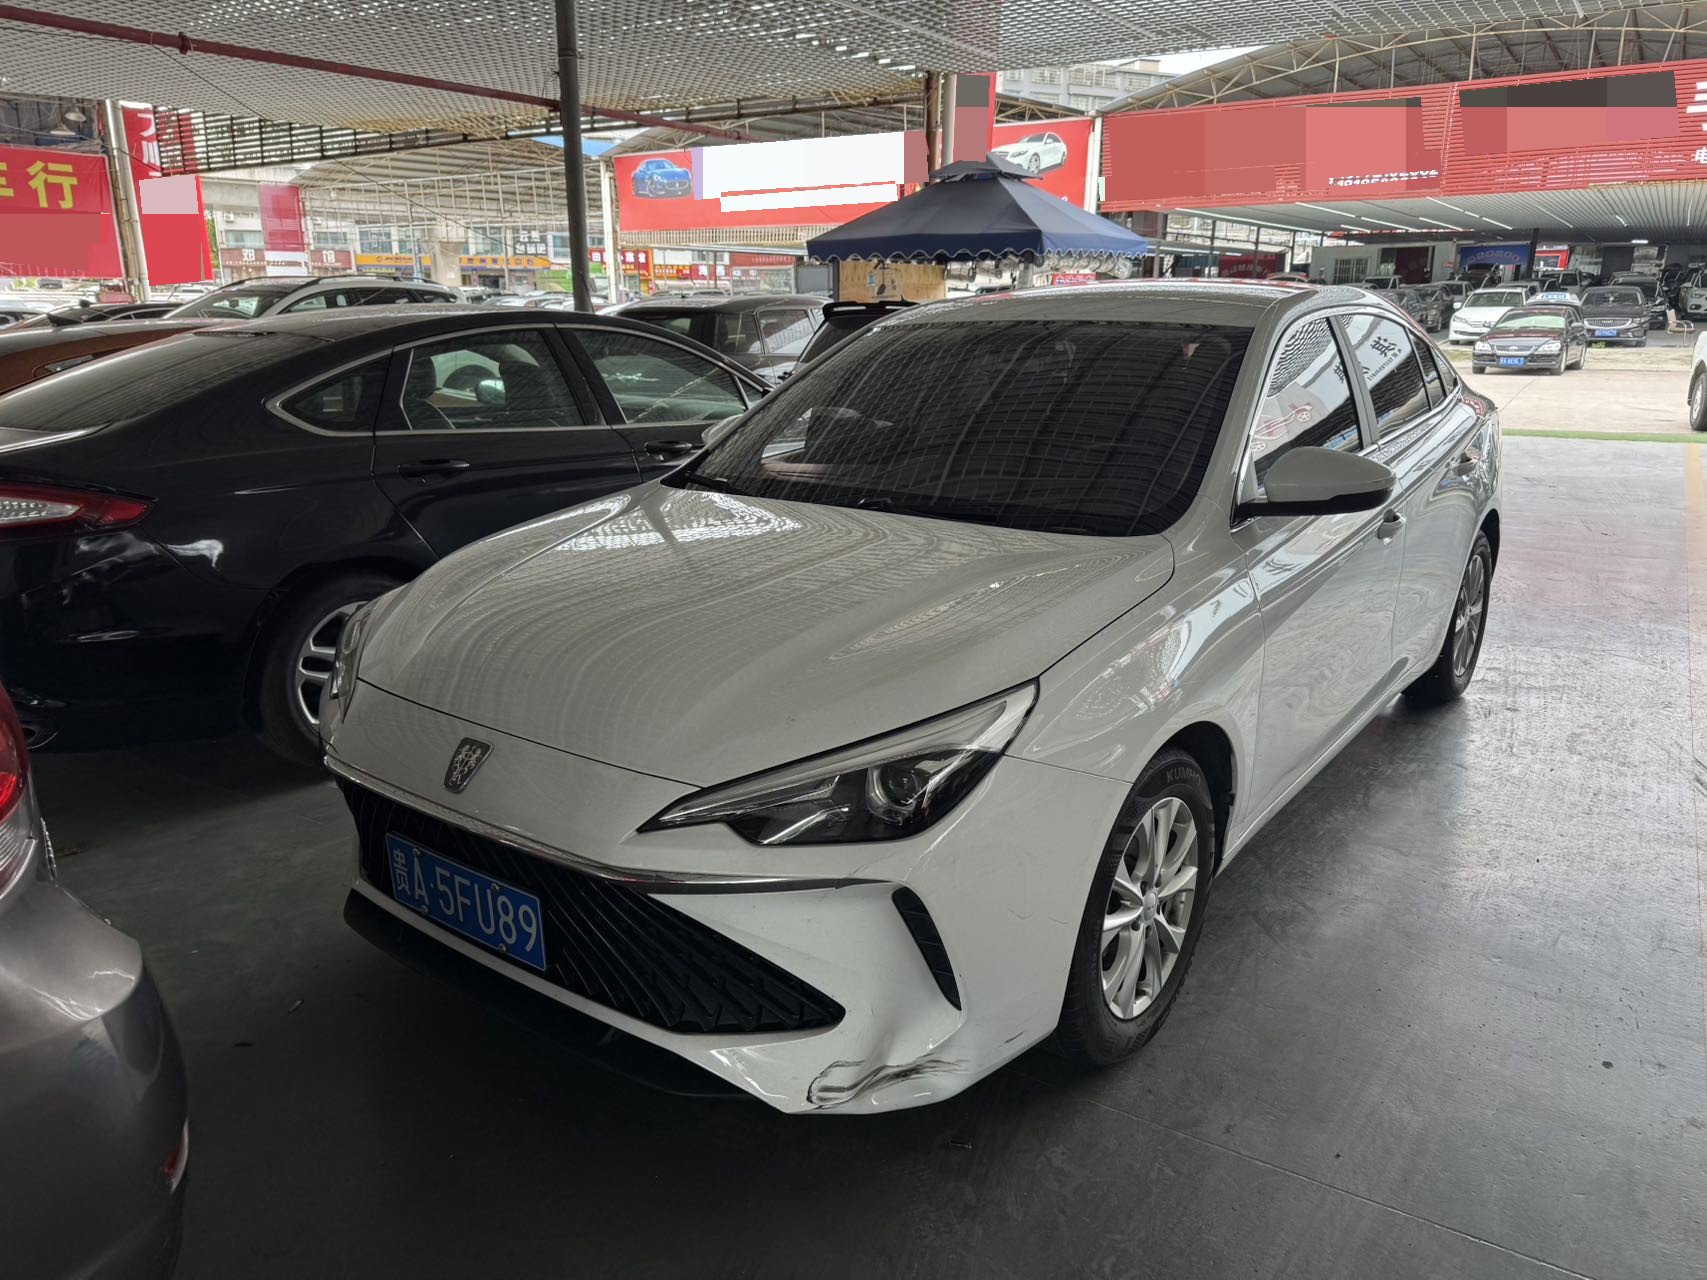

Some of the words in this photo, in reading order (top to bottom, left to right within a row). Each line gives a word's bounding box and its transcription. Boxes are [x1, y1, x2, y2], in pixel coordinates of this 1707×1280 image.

[0, 160, 78, 209] 行
[1166, 766, 1201, 786] KUMHO
[392, 848, 538, 953] 贵A·5FU89
